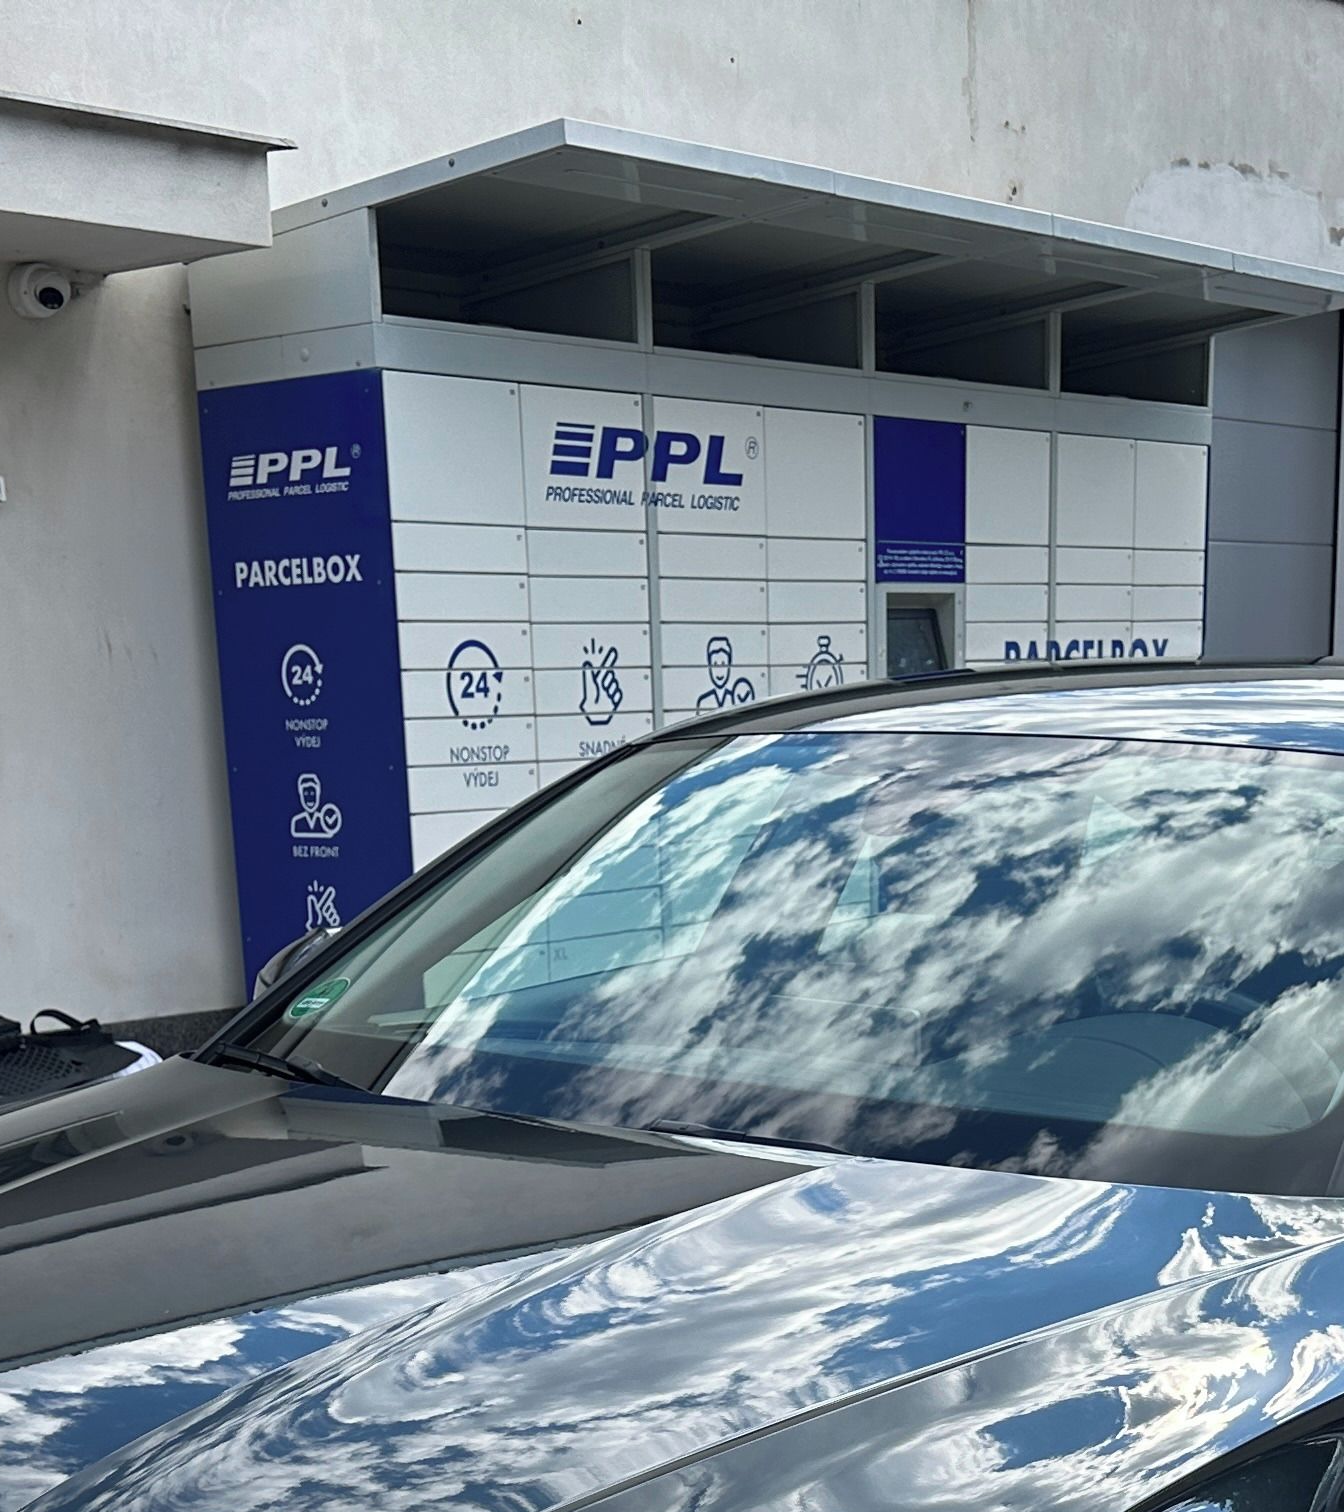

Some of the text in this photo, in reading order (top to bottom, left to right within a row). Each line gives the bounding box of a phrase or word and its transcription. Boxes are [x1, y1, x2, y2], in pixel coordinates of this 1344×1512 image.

[227, 481, 350, 501] PROFESSIONAL PARCEL LOGISTIC
[545, 486, 741, 511] PROFESSIONAL PARCEL LOGISTIC
[234, 554, 363, 588] PARCELBOX
[291, 664, 313, 685] 24
[460, 671, 490, 699] 24
[285, 718, 328, 731] NONSTOP
[294, 732, 321, 748] VÝDEJ
[449, 745, 510, 763] NONSTOP
[463, 768, 499, 788] VÝDEJ
[292, 846, 308, 857] BEZ
